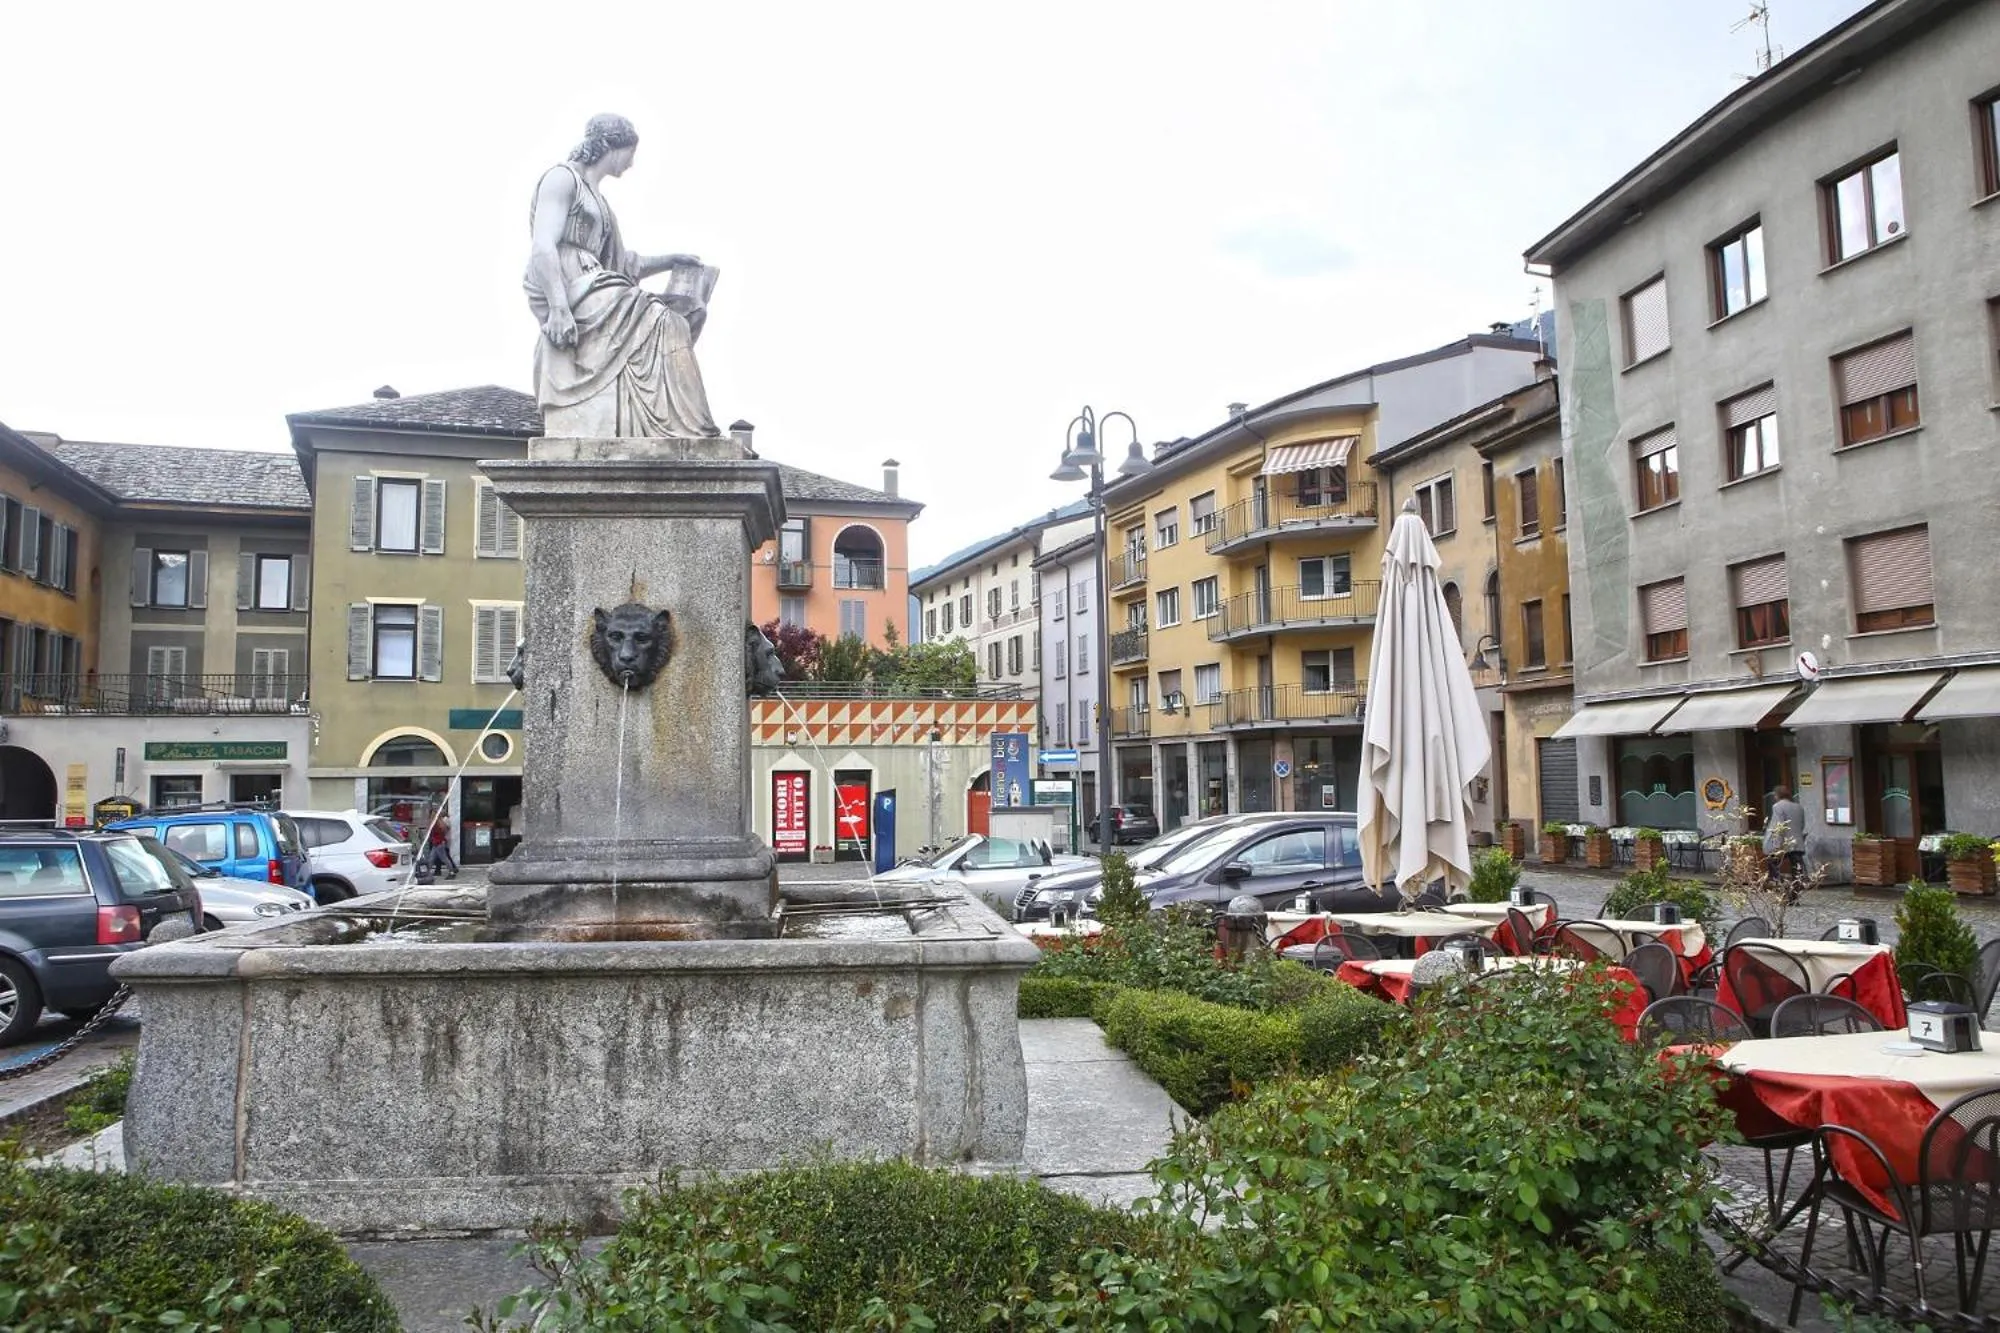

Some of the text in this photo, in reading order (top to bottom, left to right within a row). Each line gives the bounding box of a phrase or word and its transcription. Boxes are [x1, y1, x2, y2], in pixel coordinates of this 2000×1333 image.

[222, 745, 286, 756] TABACCHI
[993, 737, 1005, 758] bici
[994, 771, 1005, 808] Tirano
[776, 779, 788, 829] FUORI
[793, 776, 804, 830] TUTTO
[883, 797, 892, 810] P
[1921, 1021, 1932, 1037] 7
